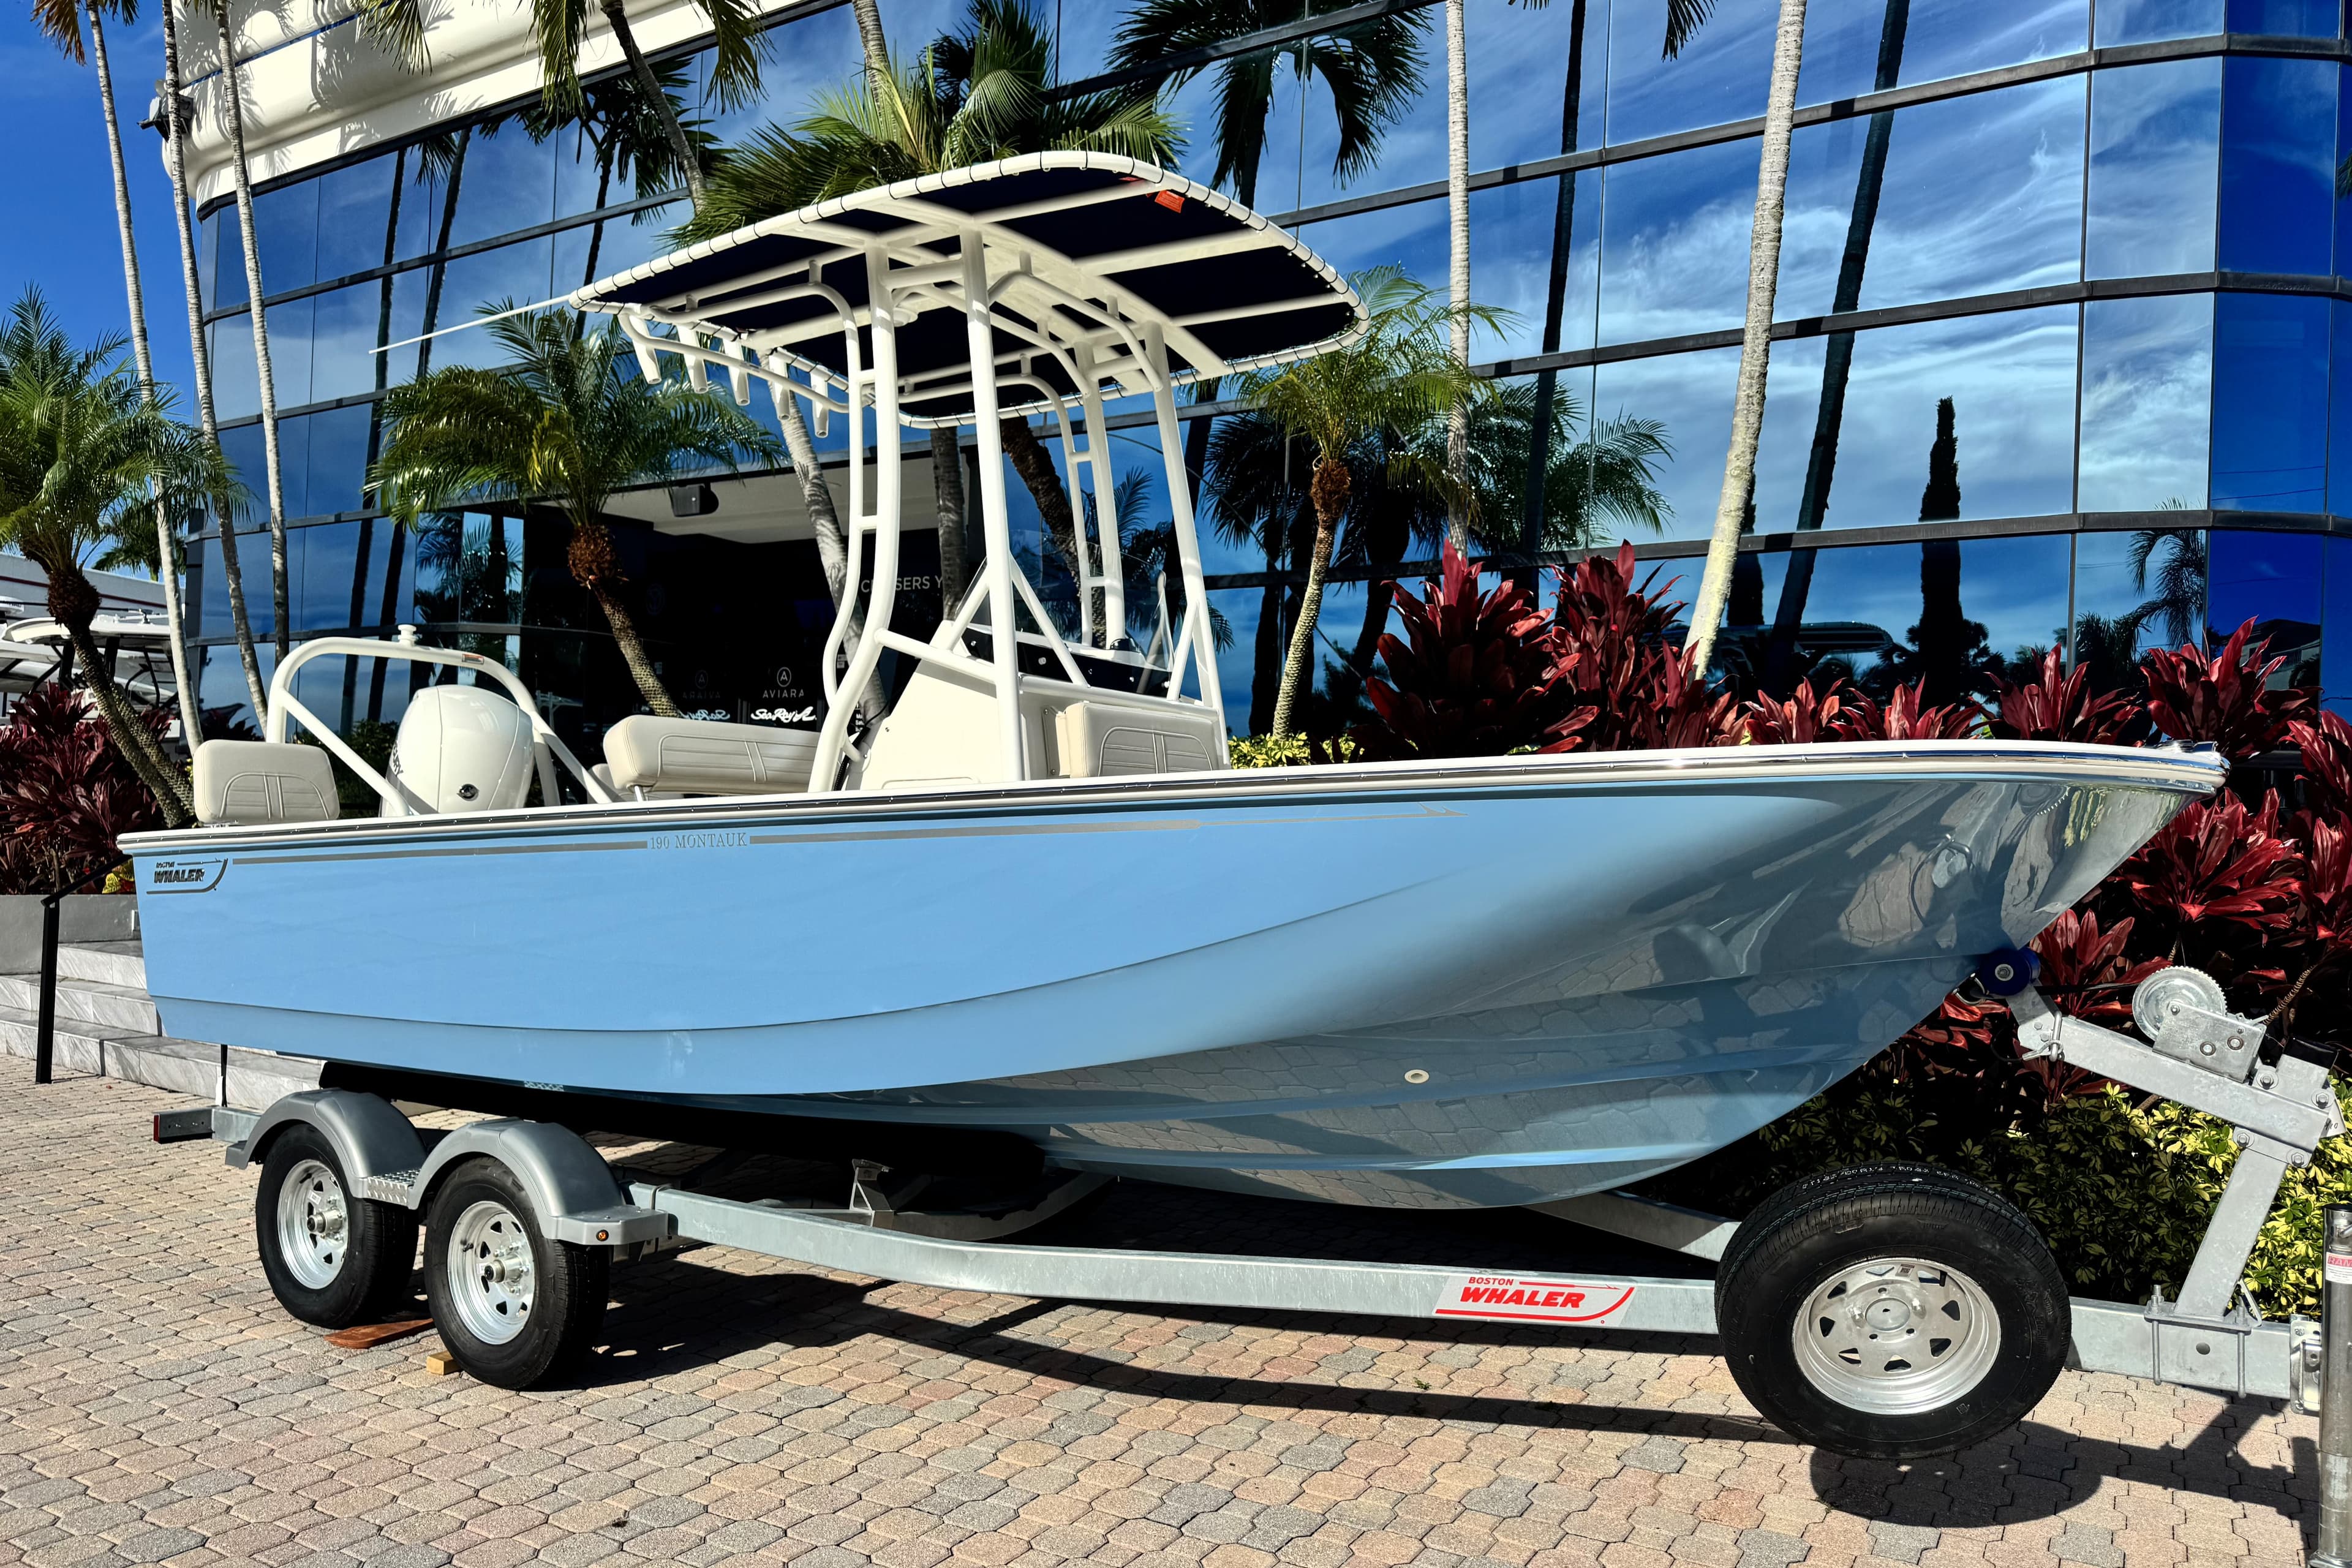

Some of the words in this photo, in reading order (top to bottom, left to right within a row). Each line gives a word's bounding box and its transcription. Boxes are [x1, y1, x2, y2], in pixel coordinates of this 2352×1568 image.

[861, 576, 930, 593] CSERS
[762, 688, 805, 699] AVIARA
[650, 836, 669, 850] 190
[675, 832, 747, 848] MONTAUK
[154, 869, 205, 883] WHALER
[1468, 1276, 1515, 1286] BOSTON
[1460, 1287, 1586, 1308] WHALER
